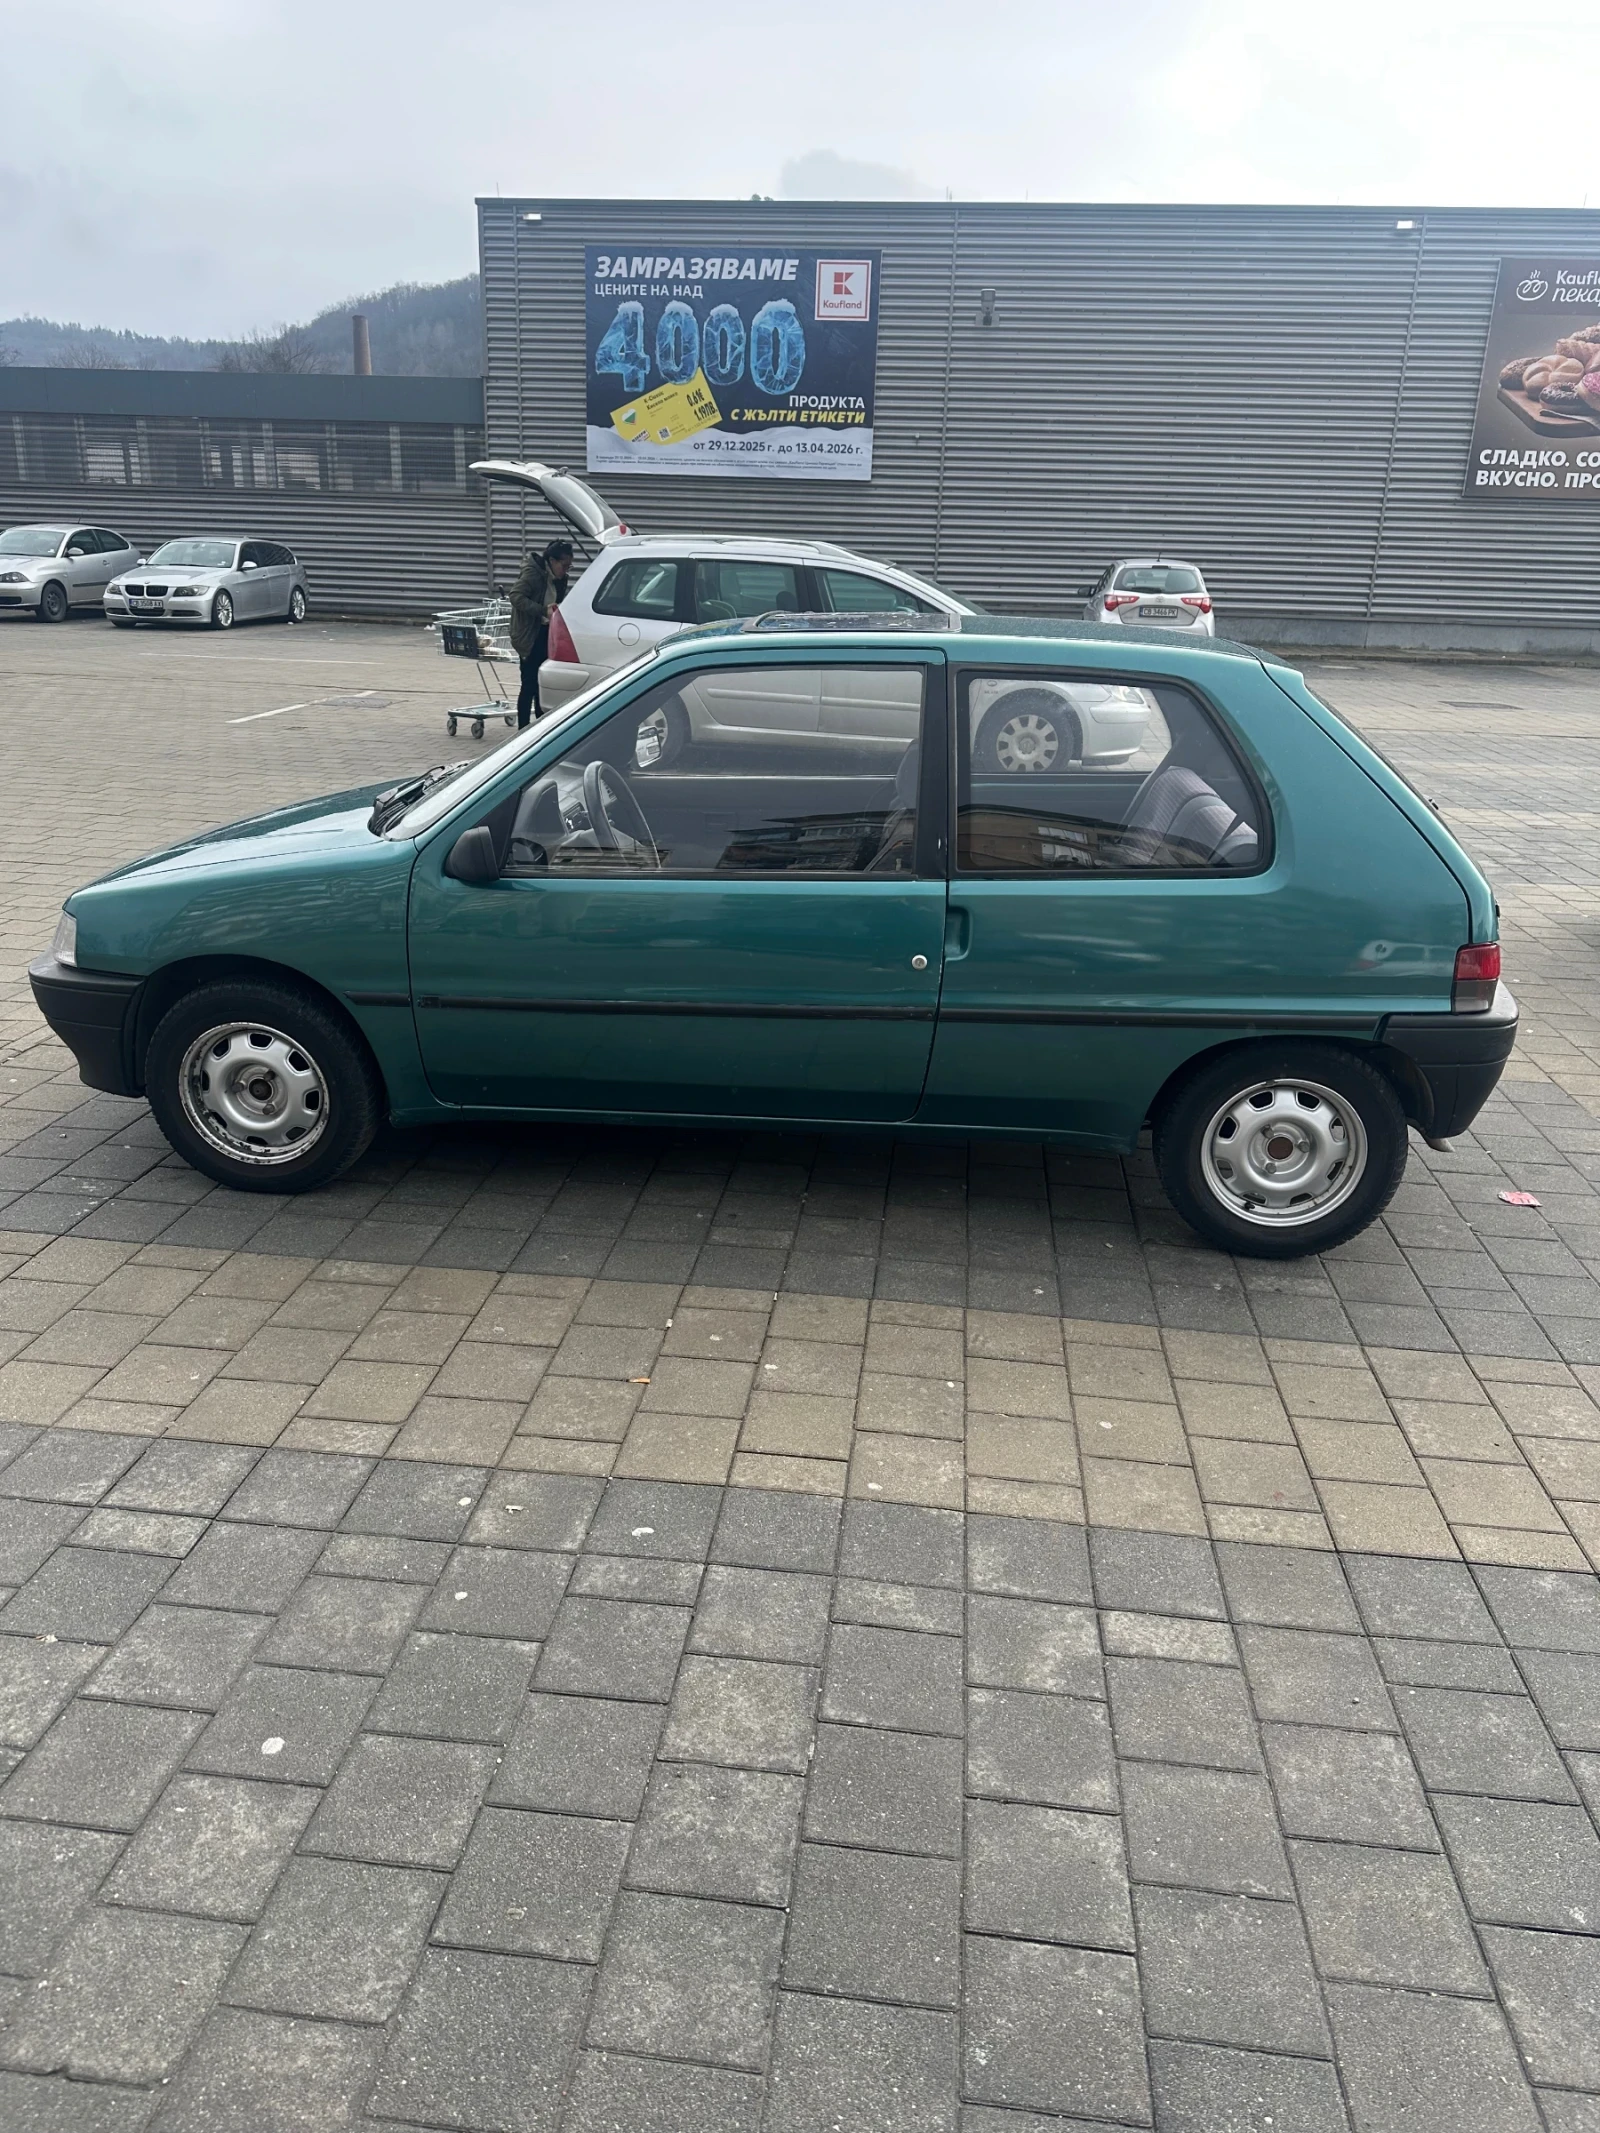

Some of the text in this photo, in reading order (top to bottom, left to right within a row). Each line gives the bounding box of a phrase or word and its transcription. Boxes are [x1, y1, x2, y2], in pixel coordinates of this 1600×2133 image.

[594, 255, 799, 280] ЗАМРАЗЯВАМЕ
[594, 283, 704, 299] ЦЕНИТЕ НА НАД
[1551, 287, 1600, 307] пека
[823, 299, 862, 309] Kaufland
[595, 298, 806, 395] 4000
[789, 395, 865, 410] ПРОДУКТА
[730, 408, 866, 423] С ЖЪЛТИ ЕТИКЕТИ
[693, 440, 863, 455] от 29.12.2025 г. до 13.04.2026 г.
[1479, 448, 1570, 469] СЛАДКО.
[1475, 469, 1559, 488] ВКУСНО.
